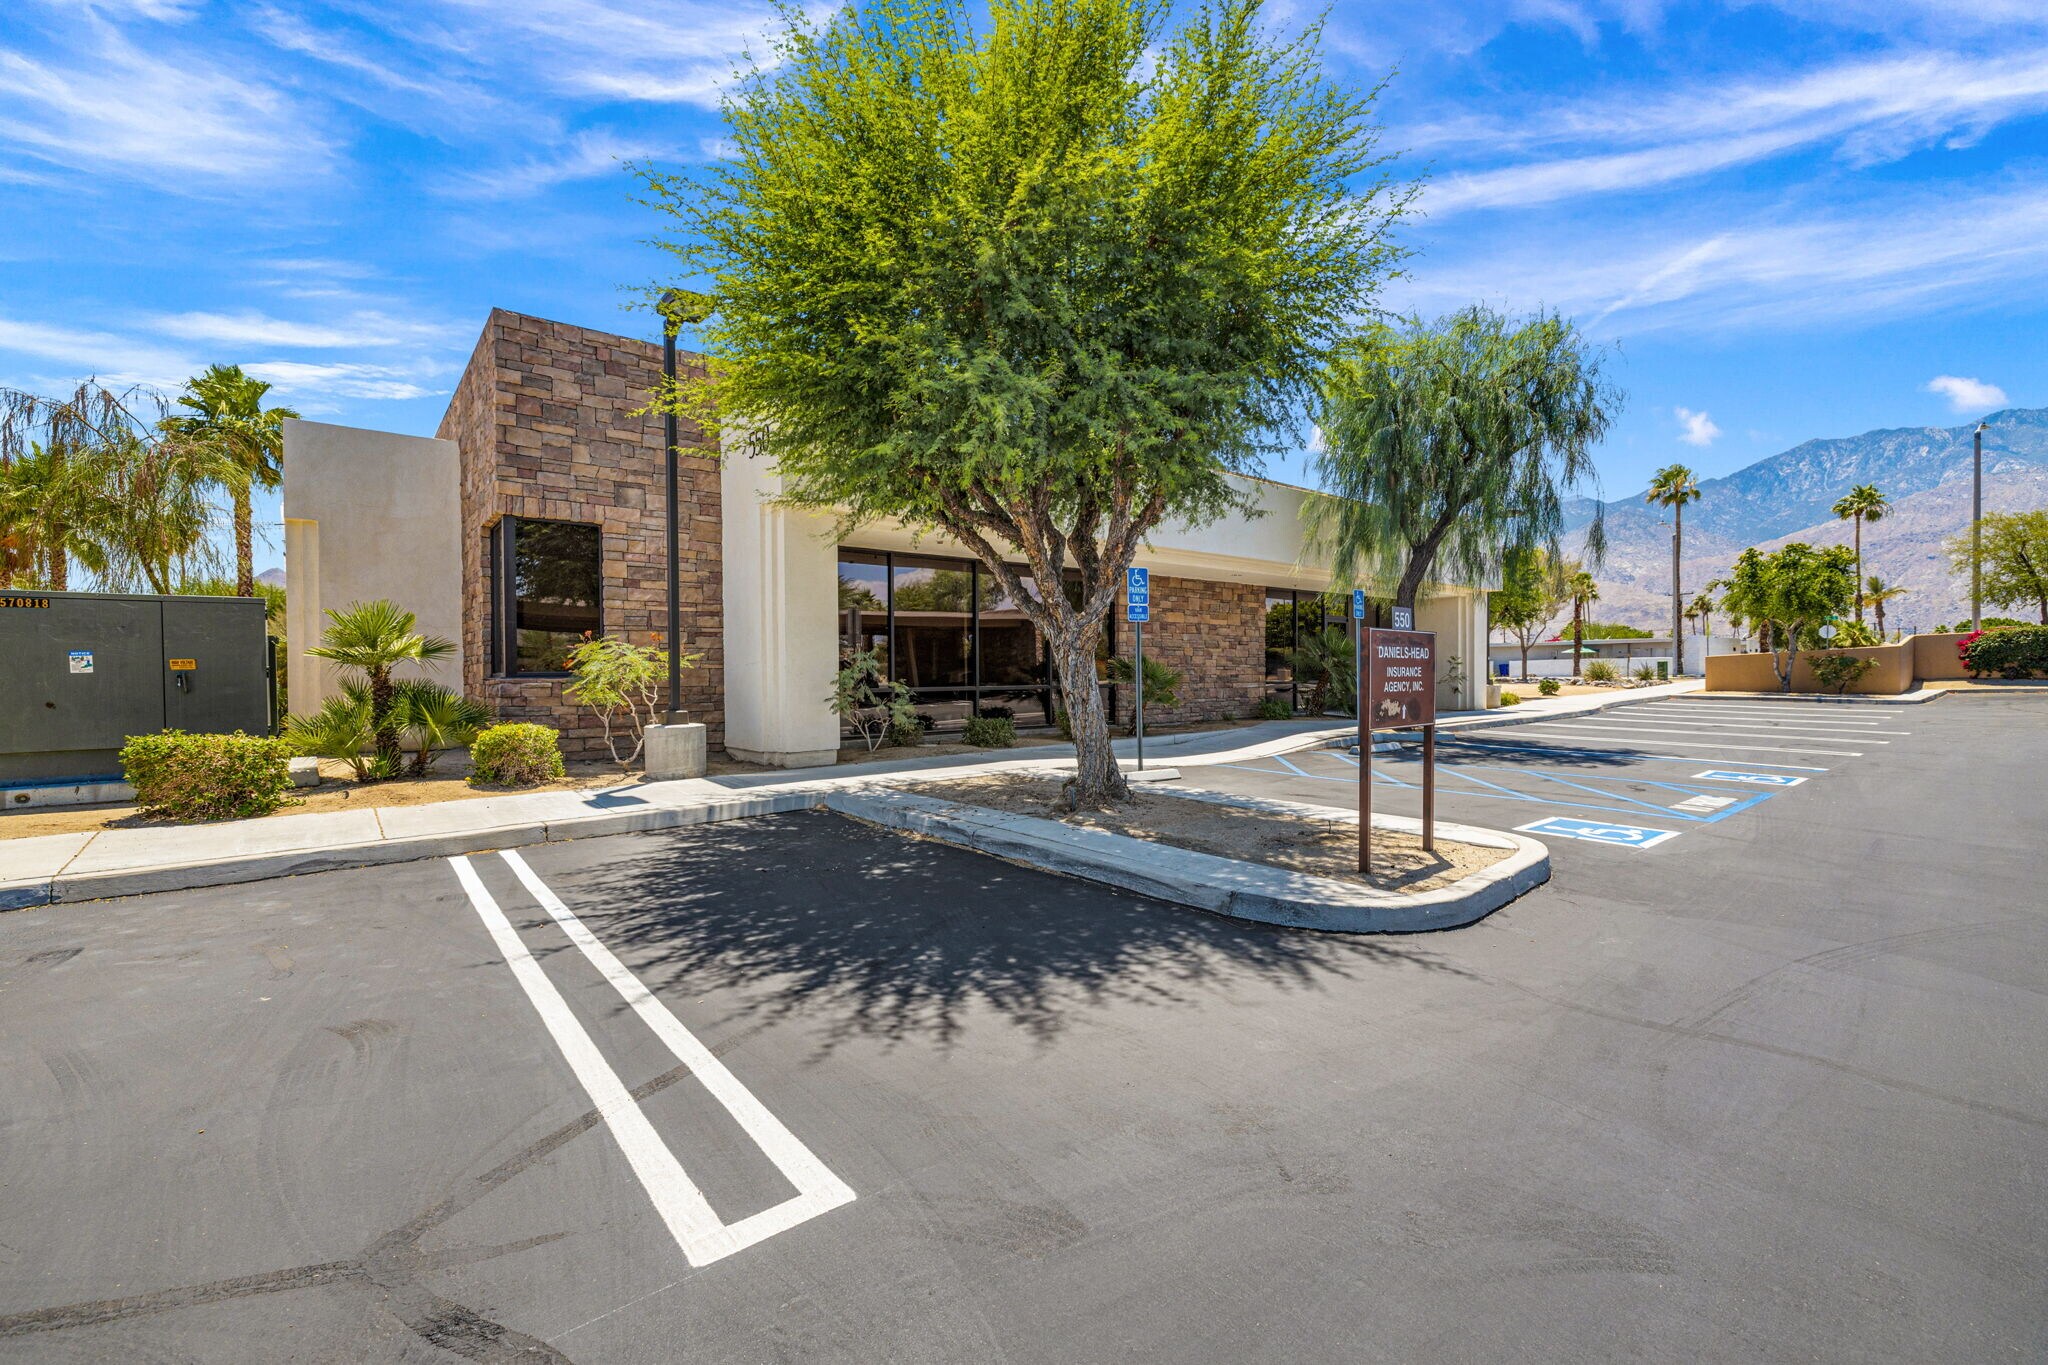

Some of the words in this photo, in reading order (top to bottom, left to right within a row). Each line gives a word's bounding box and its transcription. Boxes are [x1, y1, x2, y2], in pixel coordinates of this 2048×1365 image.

[0, 598, 48, 608] 570818
[1395, 612, 1410, 628] 550
[1378, 645, 1430, 659] DANIELS-HEAD
[1386, 666, 1421, 677] INSURANCE
[1383, 681, 1412, 693] AGENCY,
[1412, 681, 1425, 692] INC.
